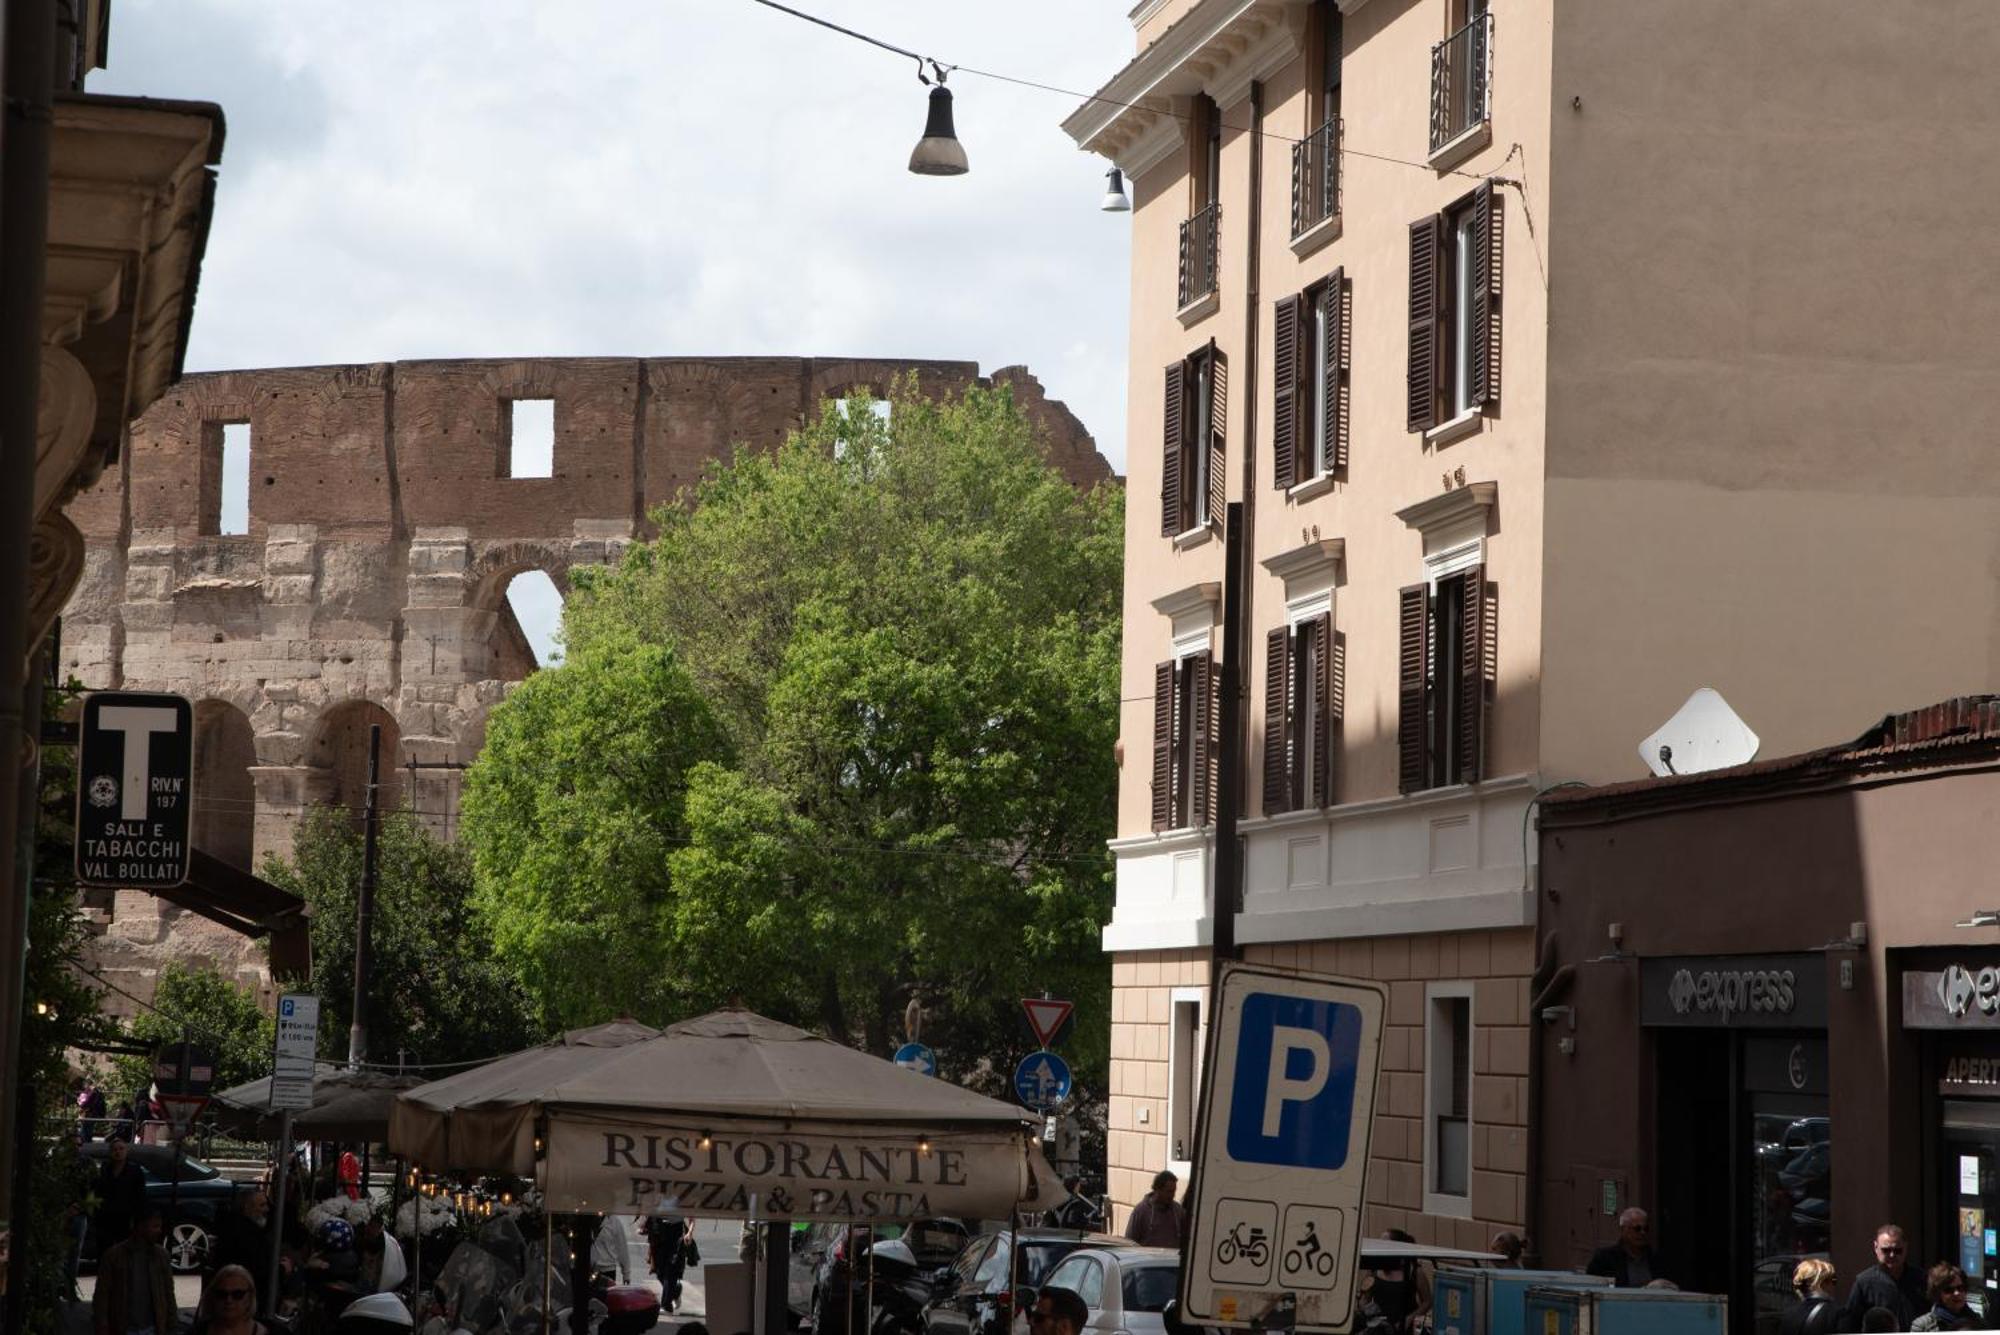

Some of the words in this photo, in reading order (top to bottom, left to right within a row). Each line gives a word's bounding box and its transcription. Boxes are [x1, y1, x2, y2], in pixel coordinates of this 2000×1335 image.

[98, 706, 178, 820] T
[157, 796, 177, 808] 197
[105, 823, 143, 836] SALI
[154, 824, 163, 837] E
[85, 840, 180, 858] TABACCHI
[85, 863, 114, 878] VAL.
[119, 863, 179, 879] BOLLATI
[284, 1001, 292, 1014] P
[1696, 970, 1795, 1024] express
[1261, 1026, 1331, 1137] P
[602, 1132, 968, 1187] RISTORANTE
[628, 1177, 750, 1212] PIZZA
[765, 1186, 795, 1214] &
[809, 1188, 934, 1217] PASTA
